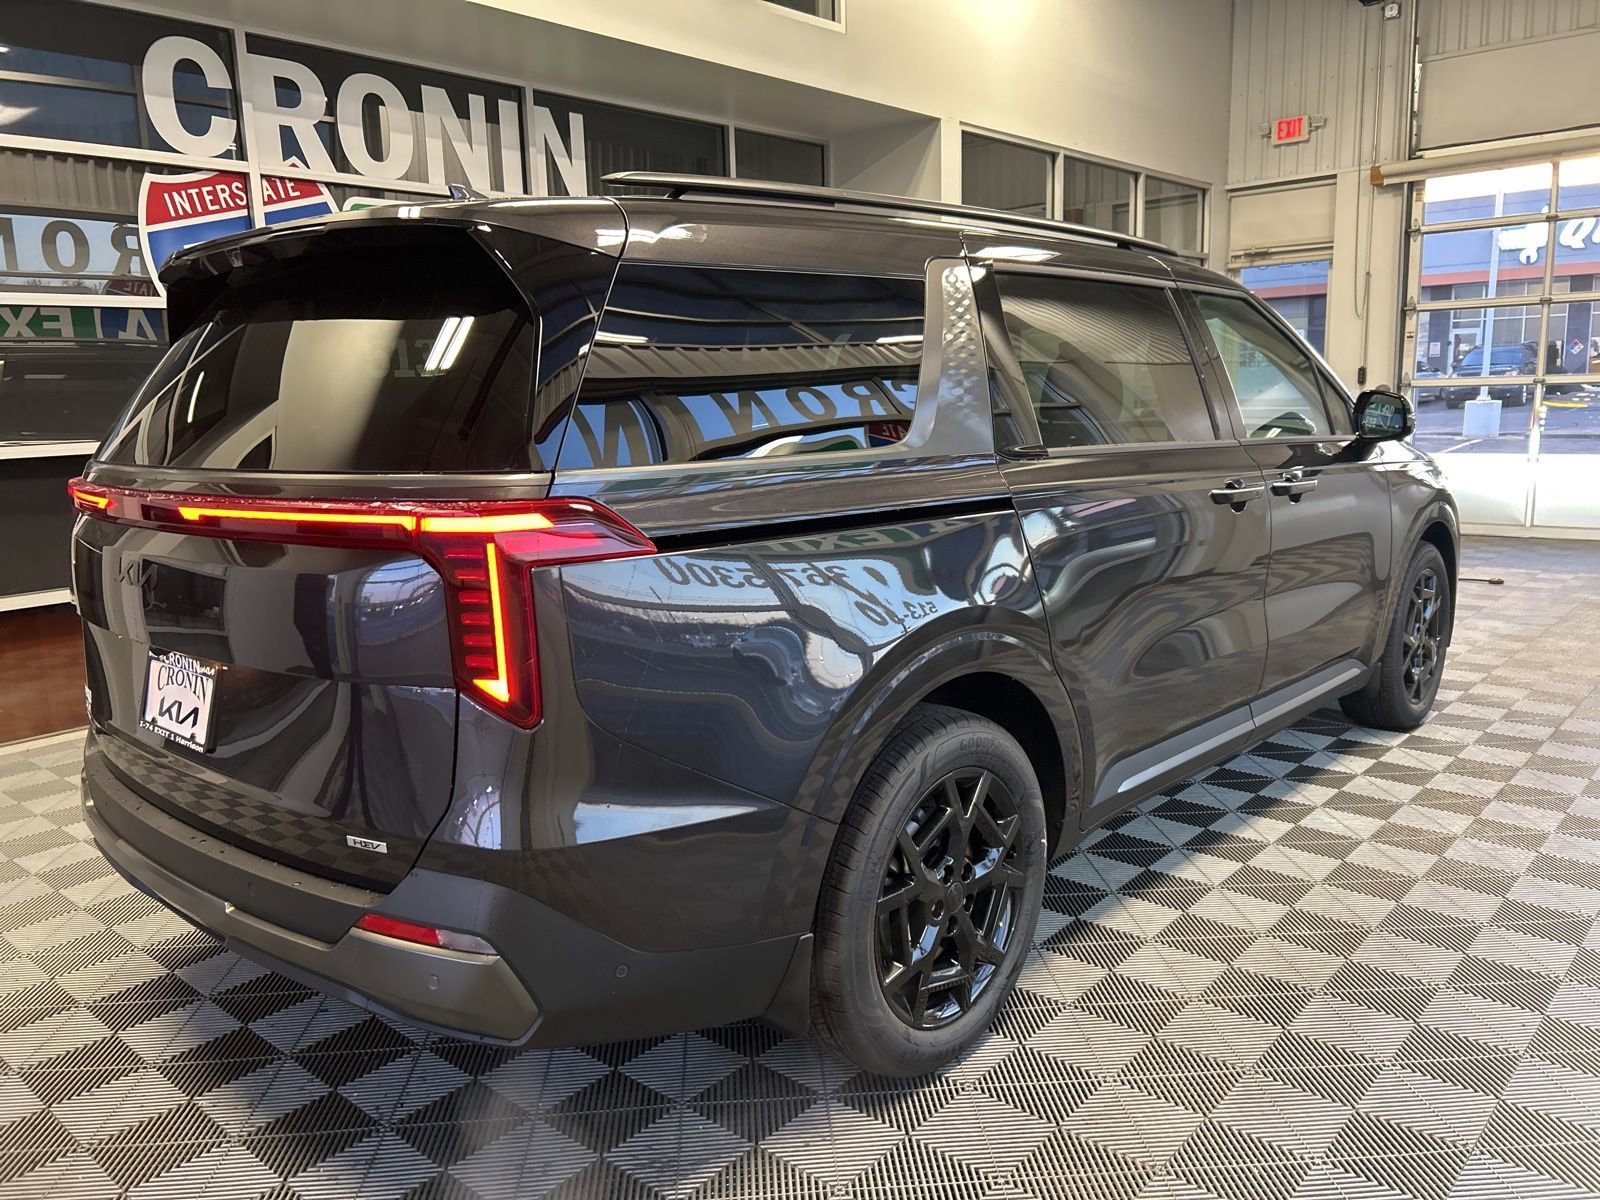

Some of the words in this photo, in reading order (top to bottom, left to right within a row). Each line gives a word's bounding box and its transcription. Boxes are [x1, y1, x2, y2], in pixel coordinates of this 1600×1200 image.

[142, 35, 588, 197] CRONIN
[1277, 117, 1303, 141] EXIT
[163, 176, 301, 218] INTERSATE
[157, 664, 209, 704] CRONIN
[159, 696, 199, 728] KIA
[139, 720, 154, 732] I-74
[154, 726, 170, 738] EXIT
[169, 733, 175, 741] 1
[175, 735, 204, 753] Harrison
[352, 838, 381, 850] HEV
